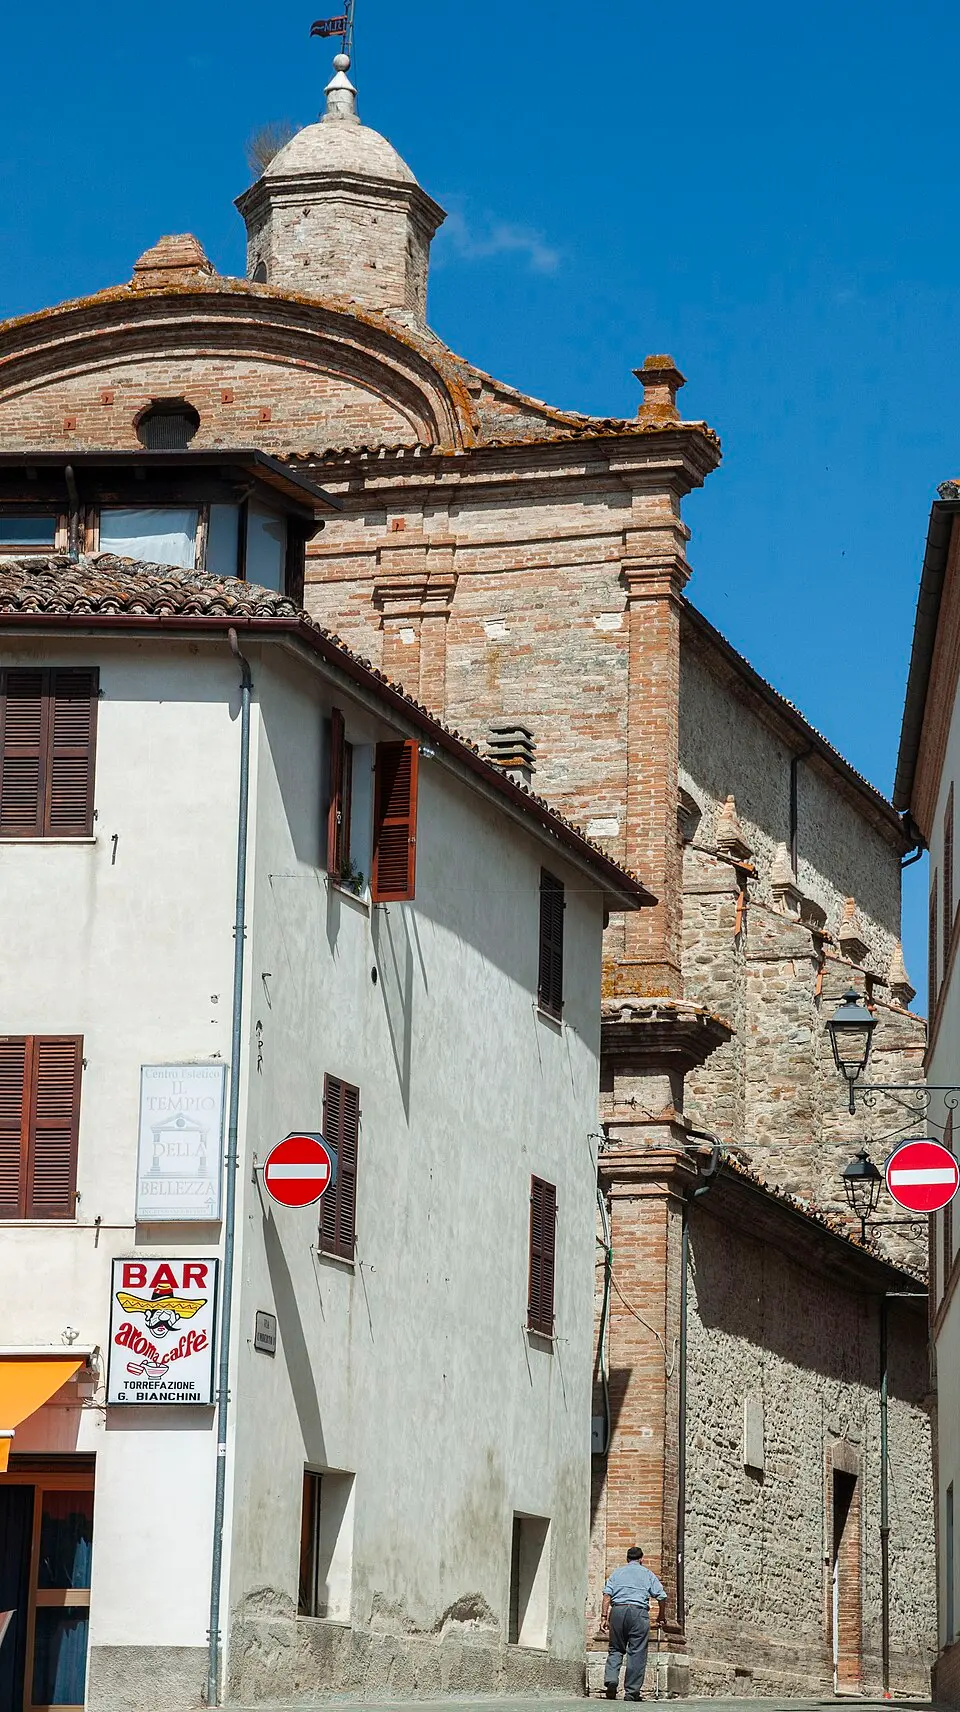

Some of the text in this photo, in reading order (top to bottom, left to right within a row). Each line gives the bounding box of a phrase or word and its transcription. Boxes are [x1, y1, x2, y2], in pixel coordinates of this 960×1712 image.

[145, 1068, 220, 1079] Centro Estetico
[172, 1080, 188, 1095] IL
[146, 1096, 215, 1111] TEMPIO
[152, 1142, 208, 1157] DELLA
[140, 1181, 216, 1196] BELLEZZA
[122, 1263, 208, 1289] BAR
[114, 1322, 210, 1366] aroma caffè
[123, 1381, 195, 1390] TORREFAZIONE
[117, 1392, 201, 1401] G. BIANCHINI
